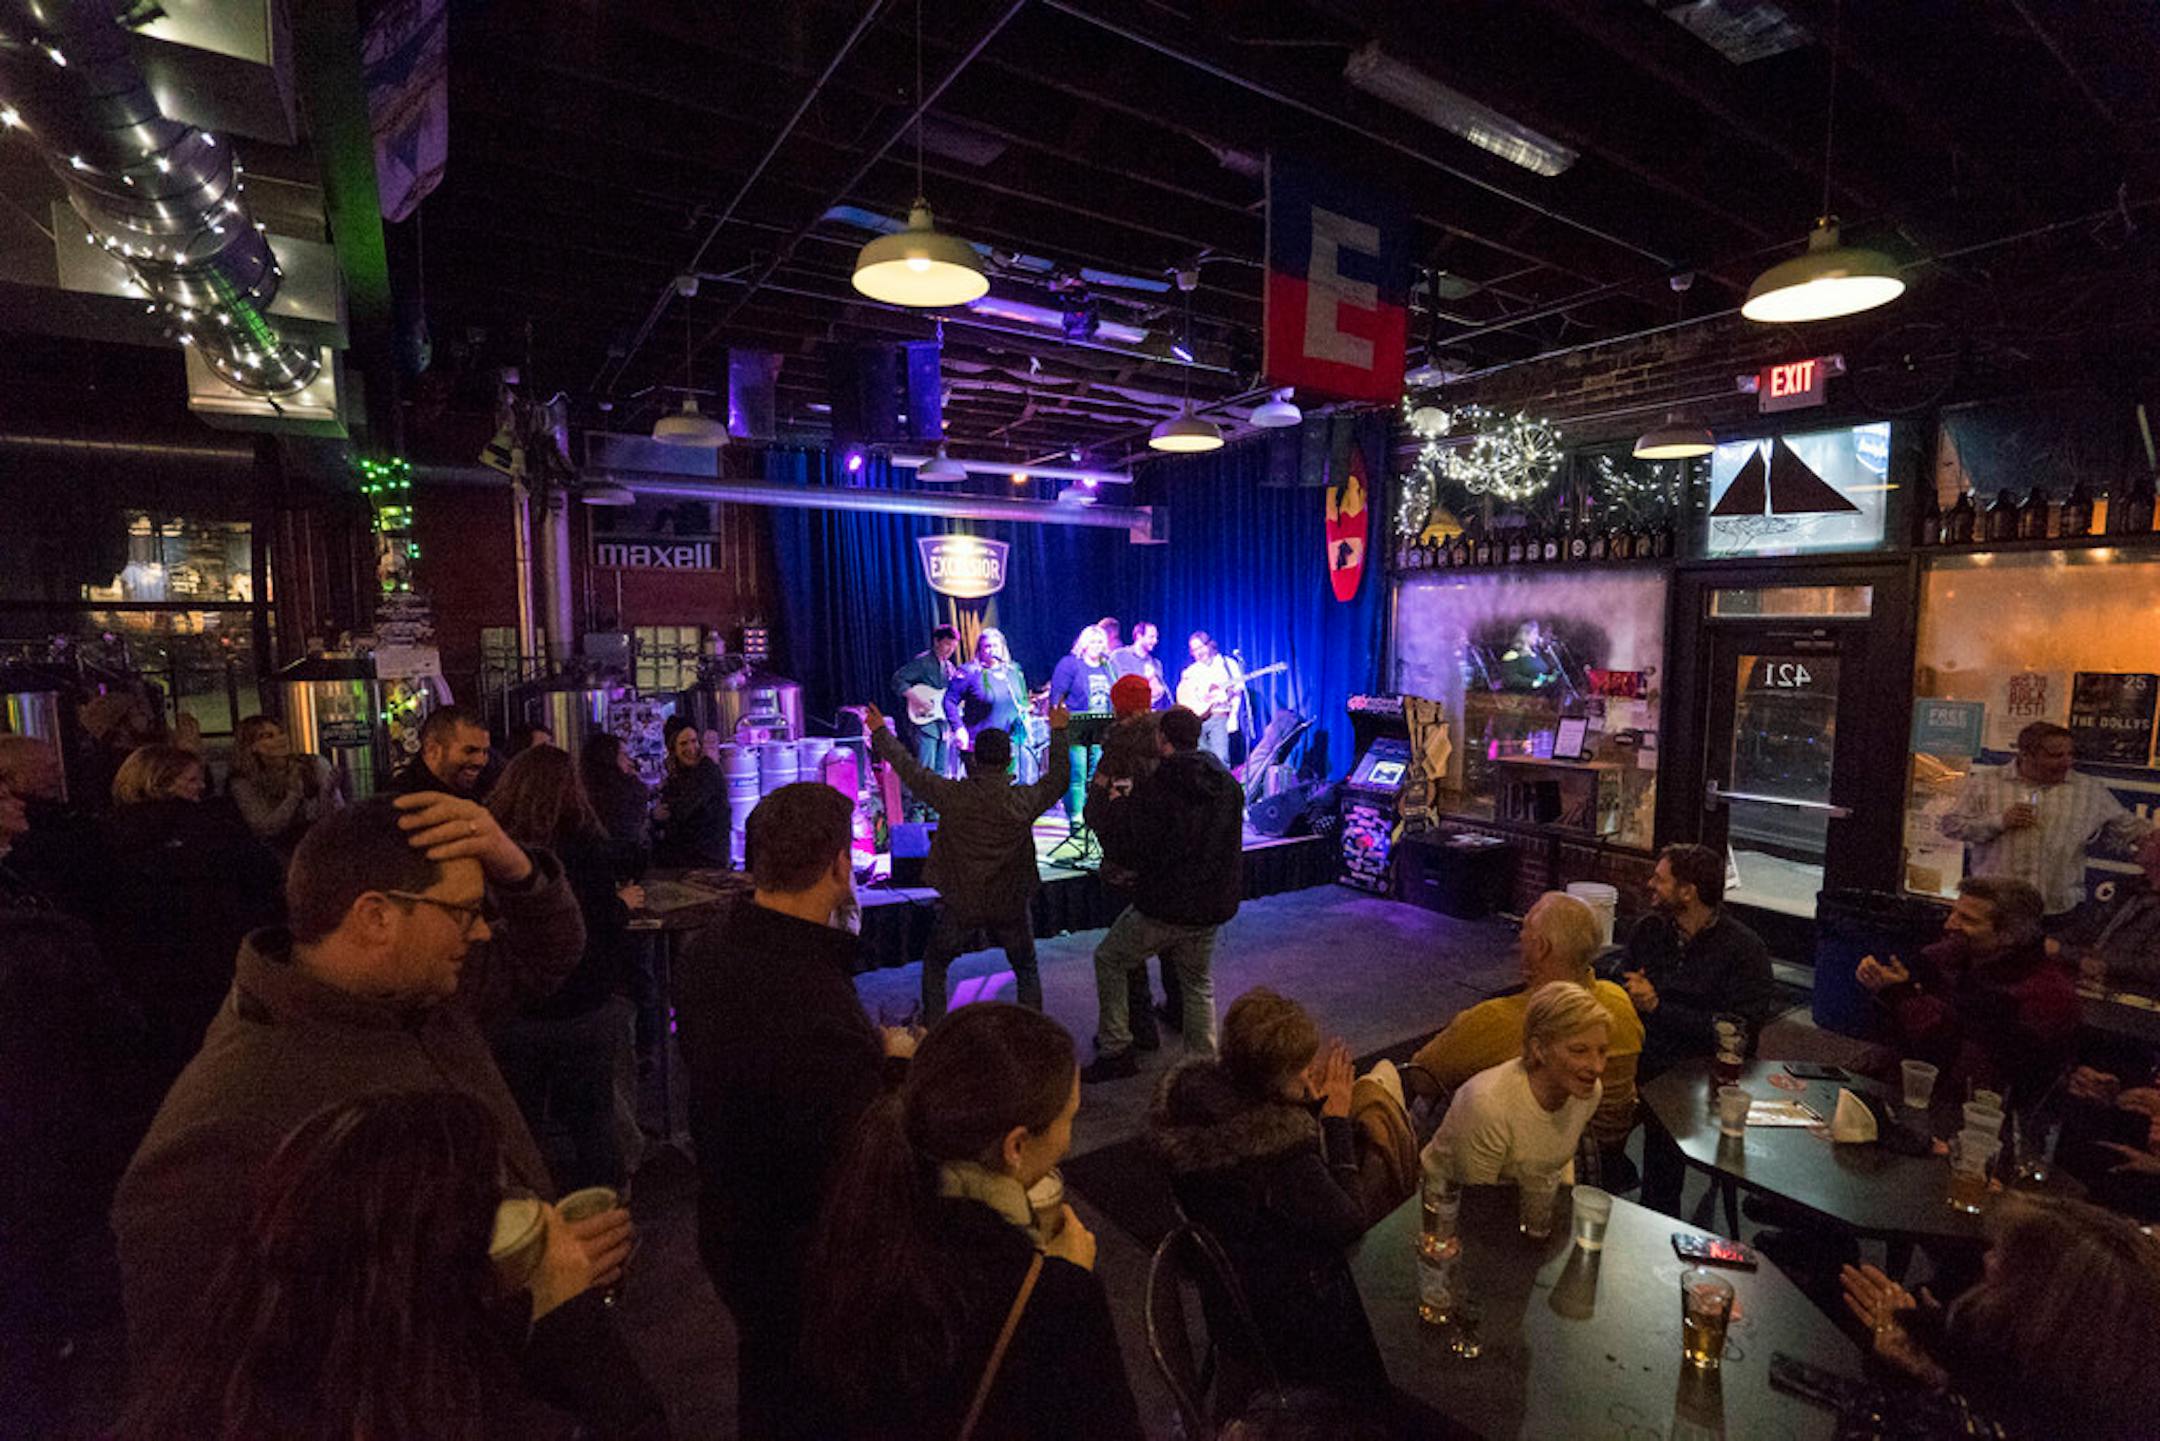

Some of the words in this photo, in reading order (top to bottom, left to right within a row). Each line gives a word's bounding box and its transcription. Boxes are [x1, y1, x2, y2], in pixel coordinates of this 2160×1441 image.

[1303, 204, 1380, 370] E
[1770, 360, 1816, 398] EXIT
[598, 543, 712, 569] maxell
[929, 556, 1001, 580] EXCSIOR
[1928, 708, 1968, 722] FREE
